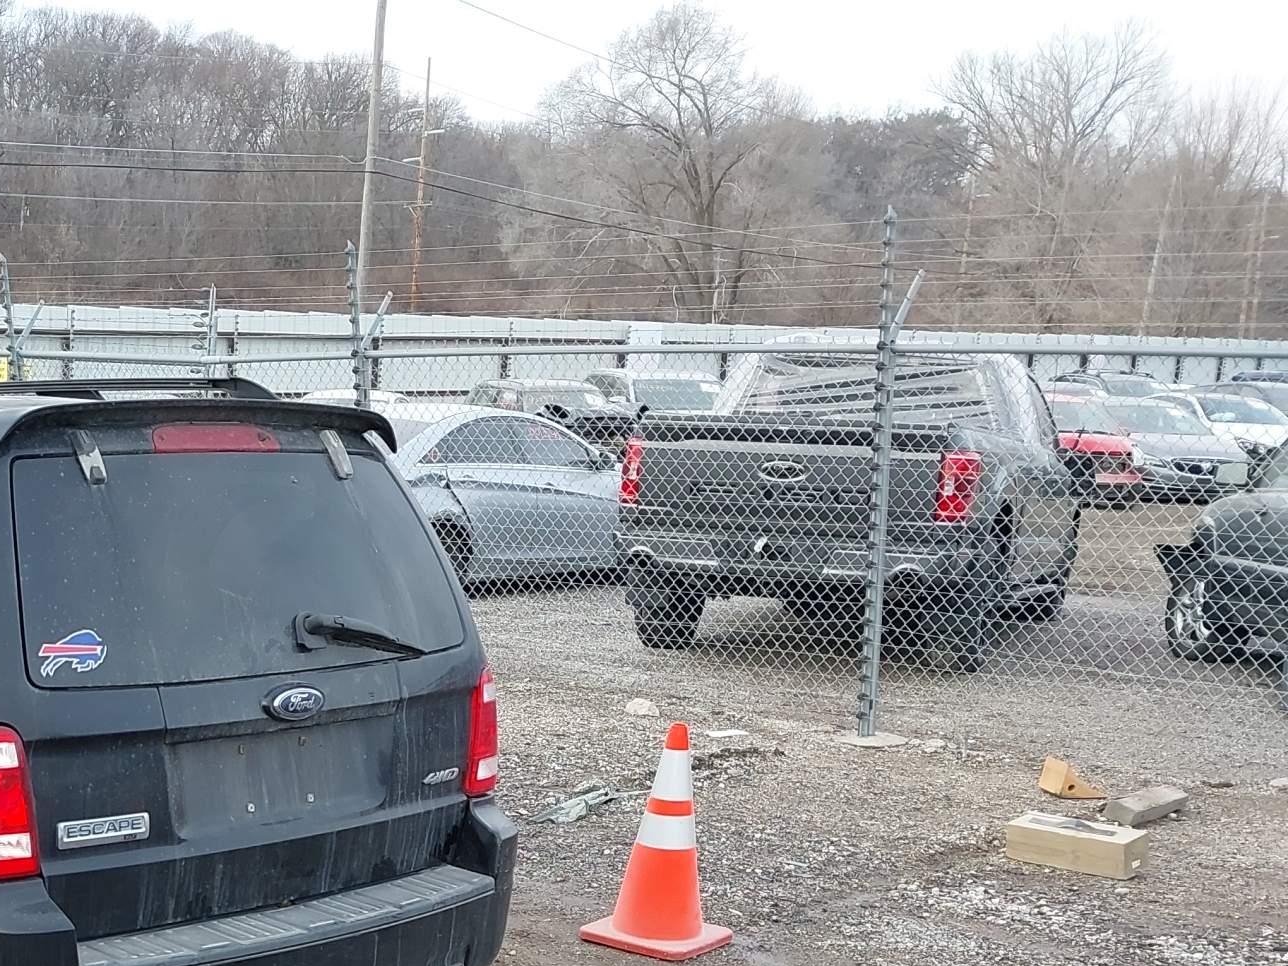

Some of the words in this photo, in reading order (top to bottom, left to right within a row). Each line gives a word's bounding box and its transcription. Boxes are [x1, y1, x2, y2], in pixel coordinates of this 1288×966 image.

[288, 693, 314, 712] Ford
[422, 767, 460, 785] 4WD
[65, 817, 144, 839] ESCAPE
